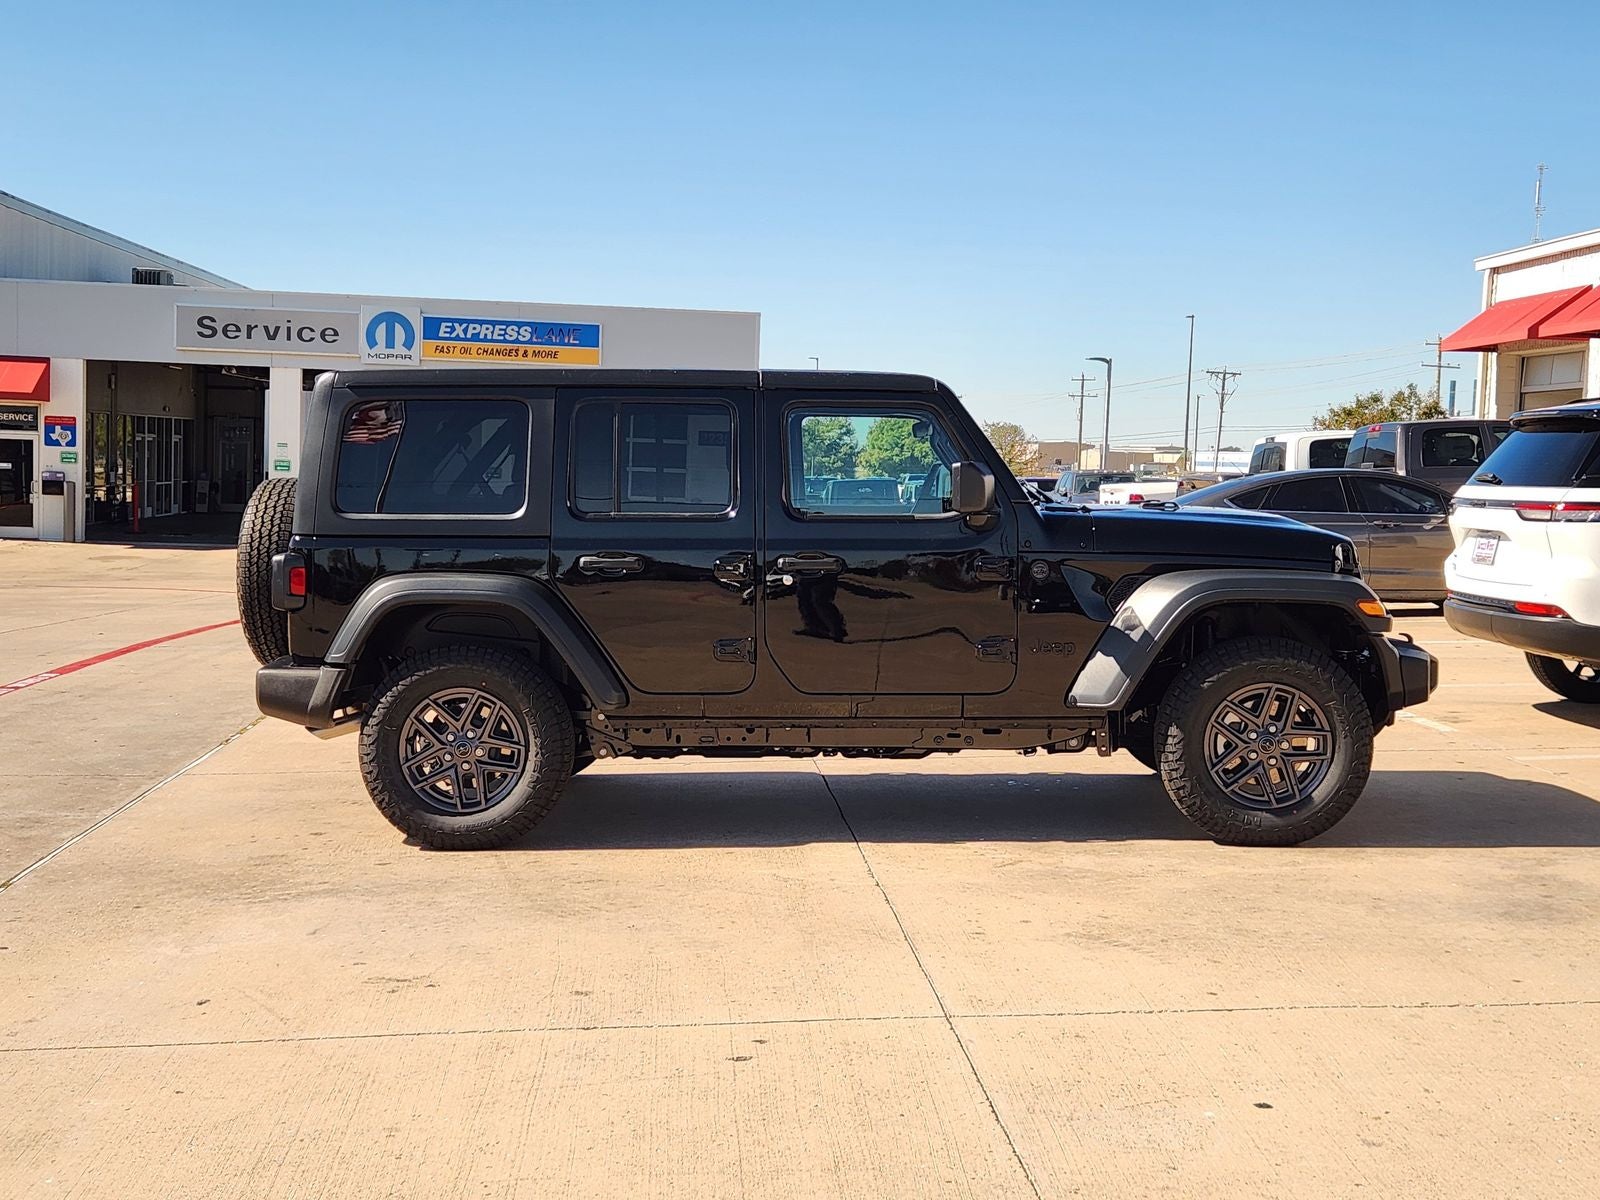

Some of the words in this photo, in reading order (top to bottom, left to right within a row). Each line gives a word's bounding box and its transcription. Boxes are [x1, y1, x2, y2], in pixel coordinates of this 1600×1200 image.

[196, 315, 340, 344] Service
[367, 353, 413, 361] MOPAR
[434, 345, 456, 355] FAST
[459, 346, 473, 355] OIL
[476, 347, 520, 358] CHANGES
[522, 350, 529, 358] &
[531, 350, 560, 359] MORE
[0, 413, 34, 422] SERVICE
[1027, 640, 1076, 656] Jeep
